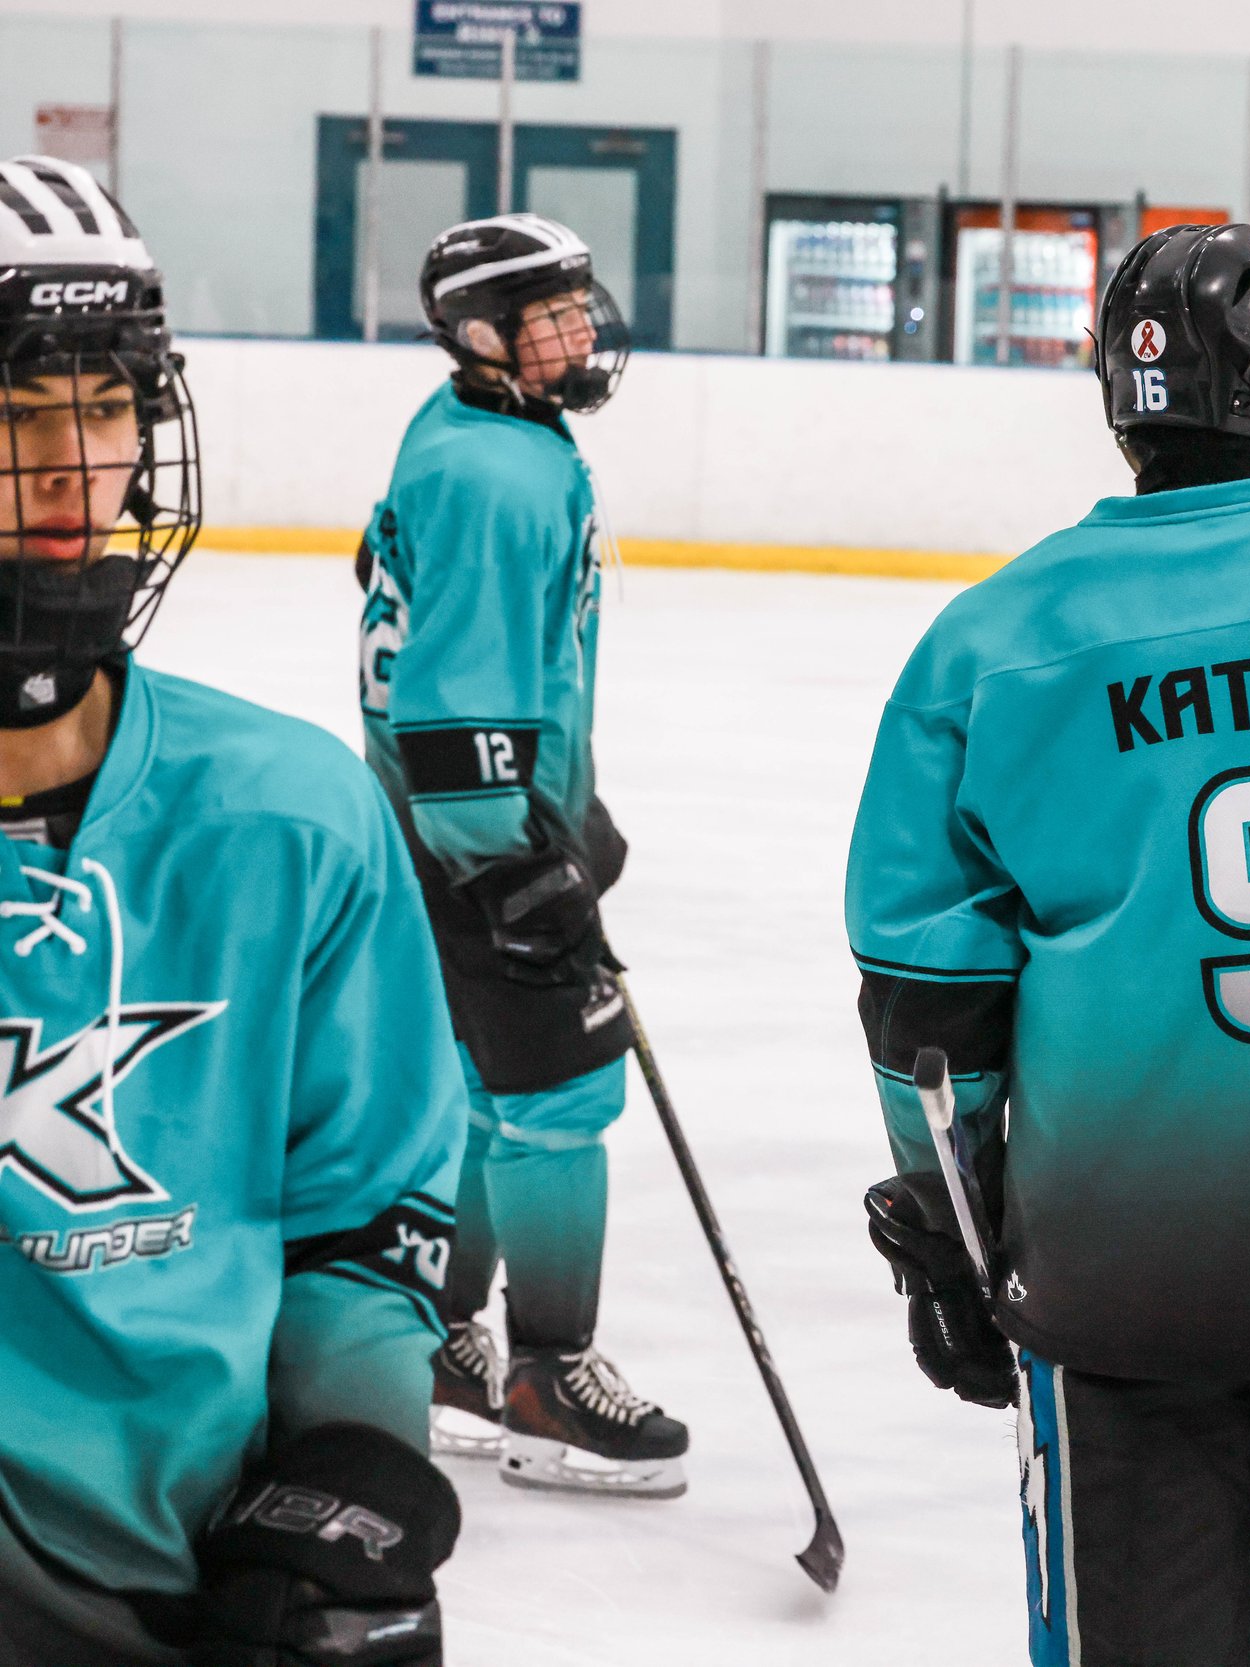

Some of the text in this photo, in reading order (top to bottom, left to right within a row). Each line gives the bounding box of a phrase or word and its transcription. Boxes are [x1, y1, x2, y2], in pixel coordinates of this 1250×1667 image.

[31, 281, 128, 306] CCM
[1132, 369, 1168, 412] 16
[474, 732, 519, 783] 12
